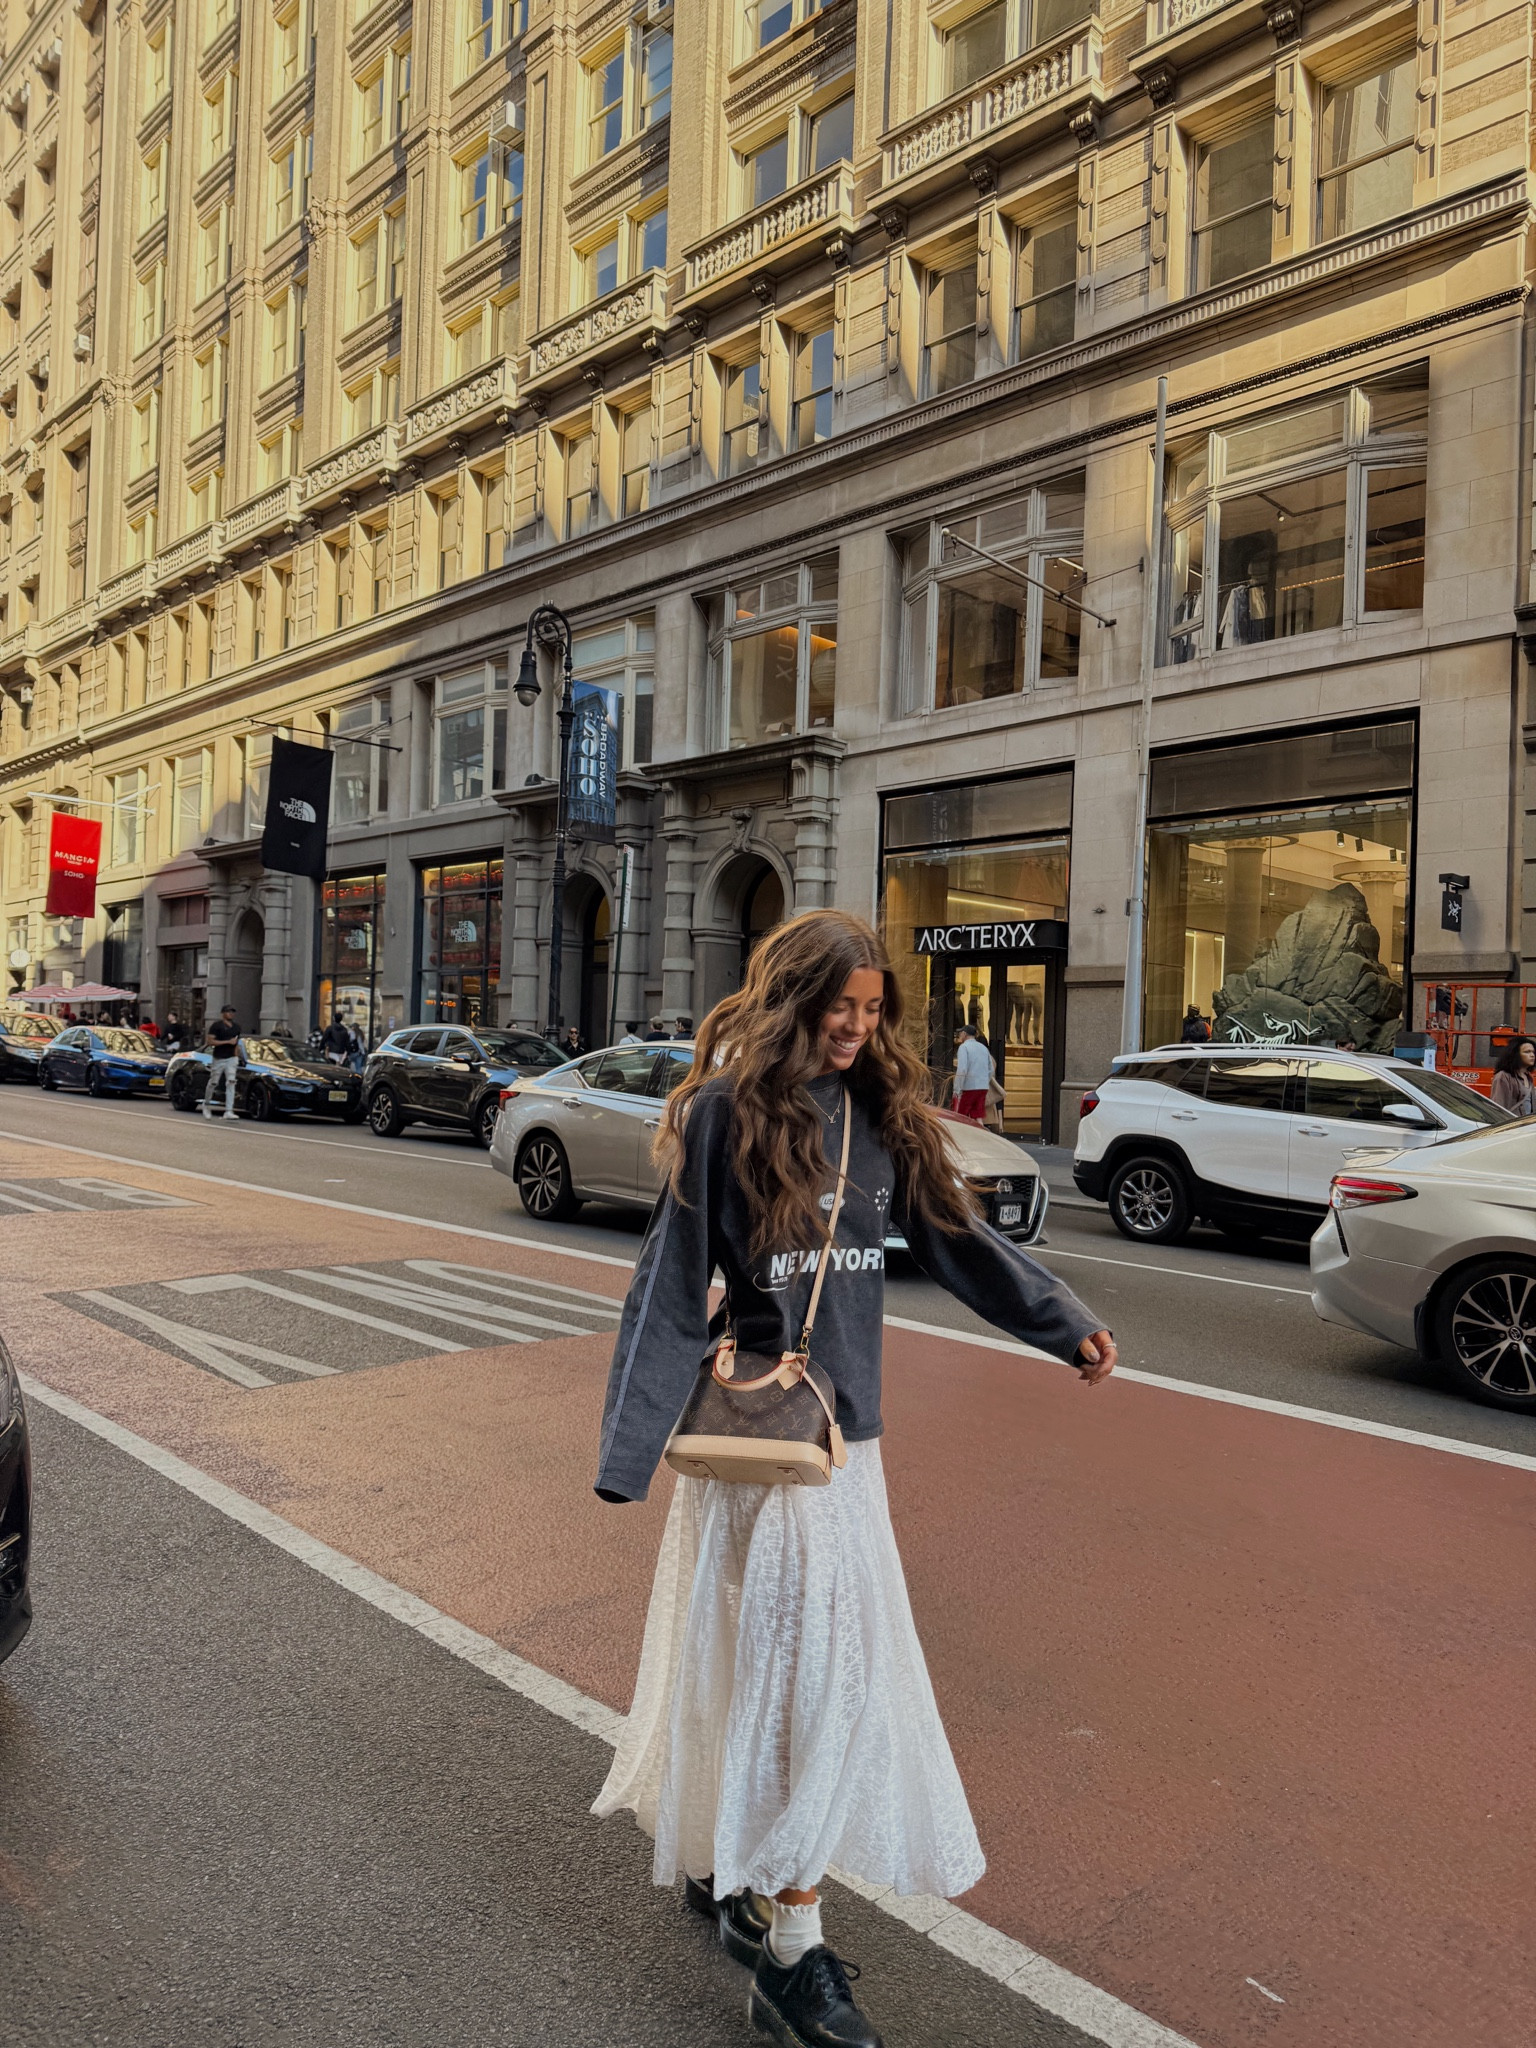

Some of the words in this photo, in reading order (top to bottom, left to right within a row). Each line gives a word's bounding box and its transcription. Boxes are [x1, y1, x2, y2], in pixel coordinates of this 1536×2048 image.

[579, 718, 598, 796] SOHO
[599, 723, 608, 798] BROADWAY
[918, 922, 1036, 952] ARC'TERYX
[770, 1249, 822, 1279] NEW
[830, 1247, 885, 1271] YOR
